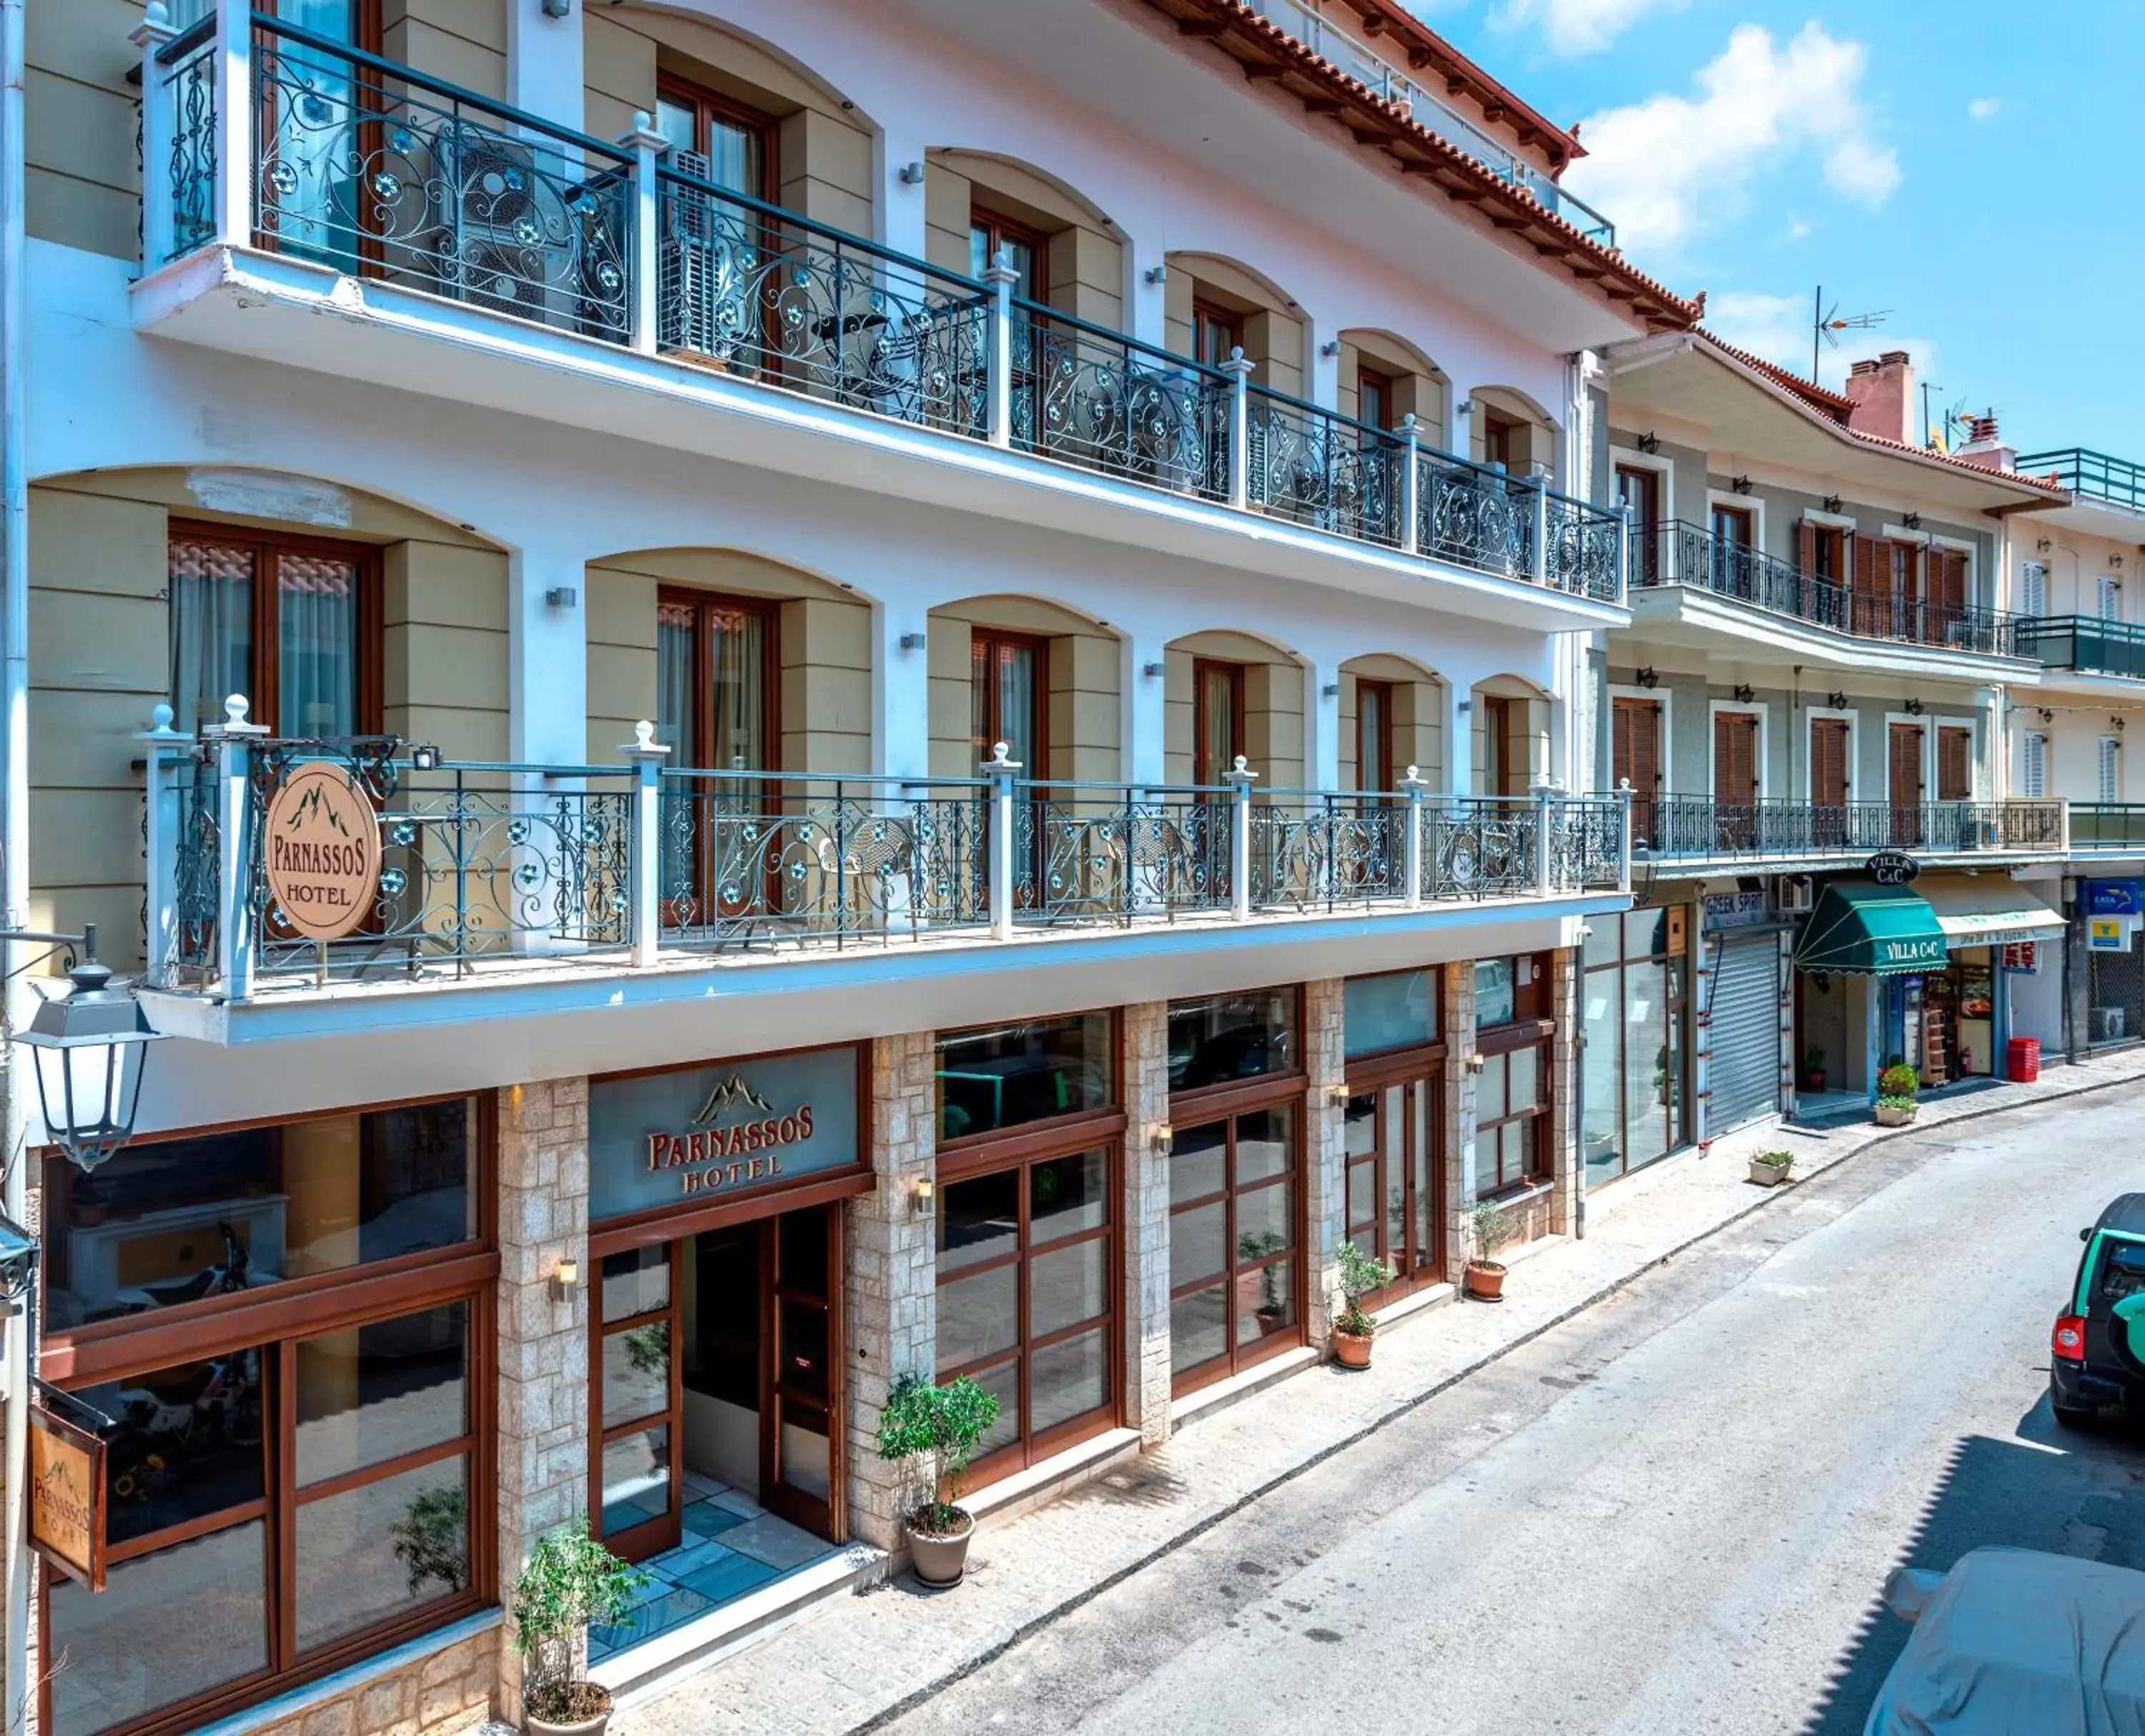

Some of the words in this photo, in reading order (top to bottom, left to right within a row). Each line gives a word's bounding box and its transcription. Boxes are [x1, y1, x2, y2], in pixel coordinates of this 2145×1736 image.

[274, 834, 365, 877] PARNASSOS
[1870, 857, 1912, 872] VILLA
[1876, 868, 1904, 884] C&C
[287, 884, 351, 907] HOTEL
[1707, 896, 1735, 916] GREEK
[1888, 942, 1918, 960] VILLA
[647, 1104, 814, 1171] PARNASSOS
[682, 1154, 782, 1193] HOTEL
[34, 1476, 89, 1533] PARNASSOS
